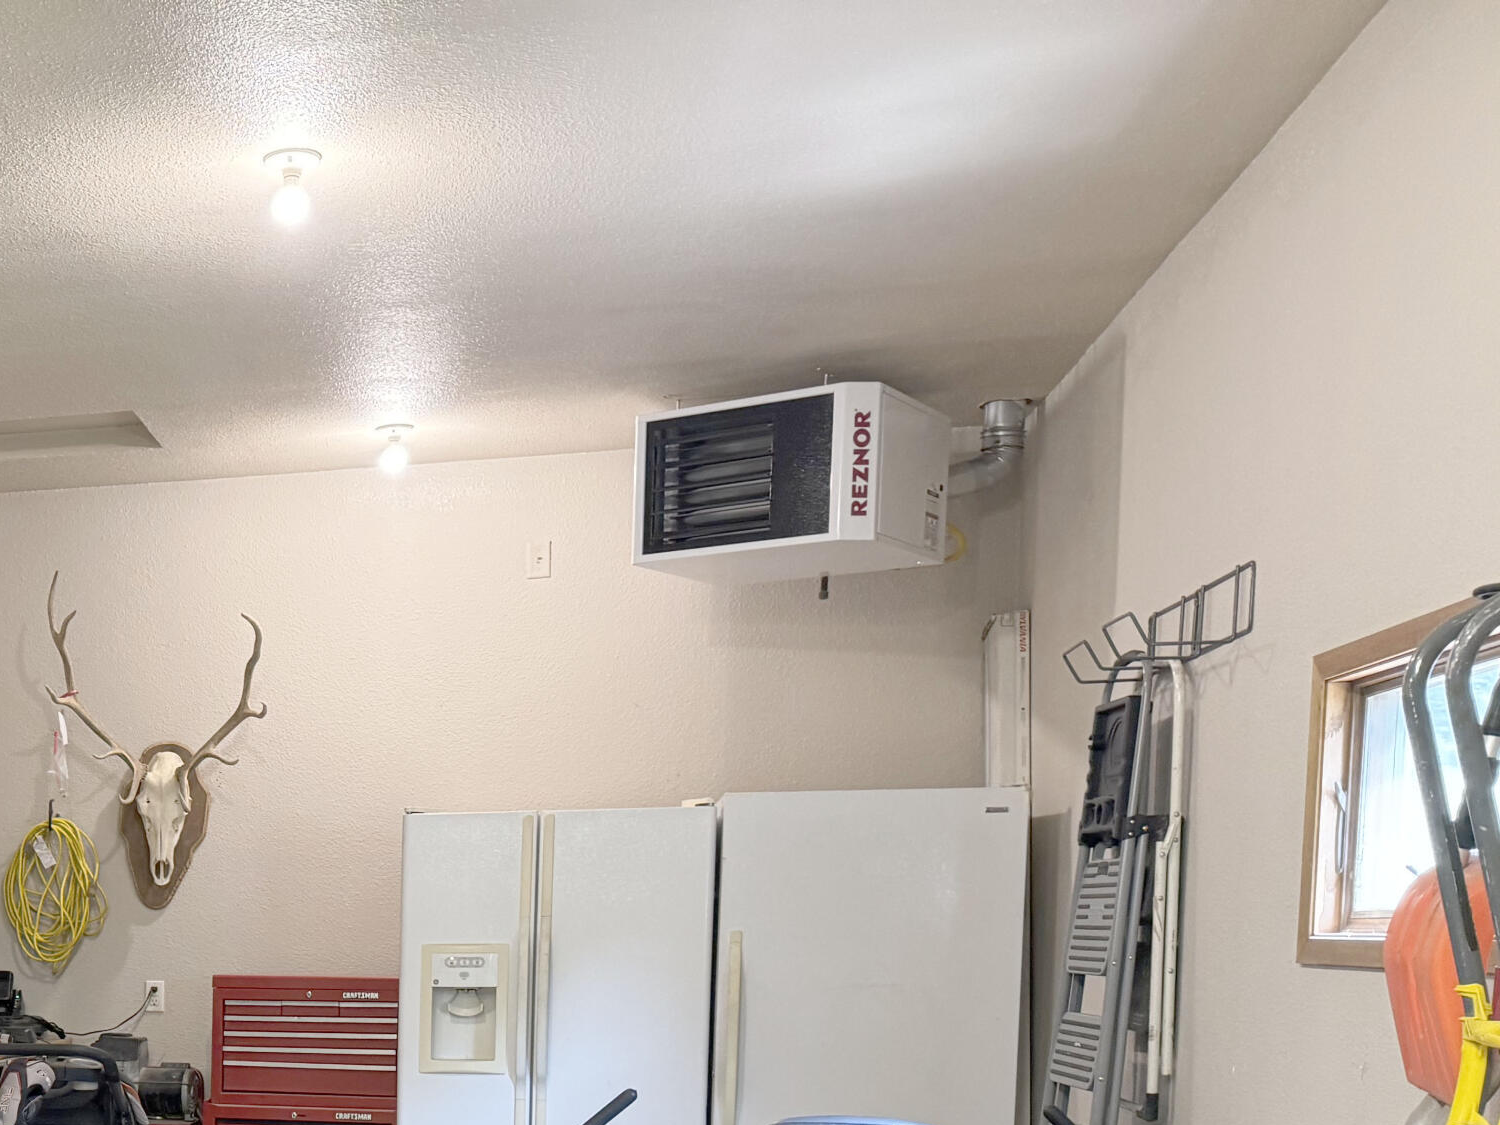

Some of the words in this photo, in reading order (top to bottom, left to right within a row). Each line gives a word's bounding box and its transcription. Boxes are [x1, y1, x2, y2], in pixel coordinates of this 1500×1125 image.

[850, 411, 871, 516] REZNOR
[342, 991, 379, 1000] CRAFTSMAN
[335, 1112, 372, 1121] CRAFTSMAN
